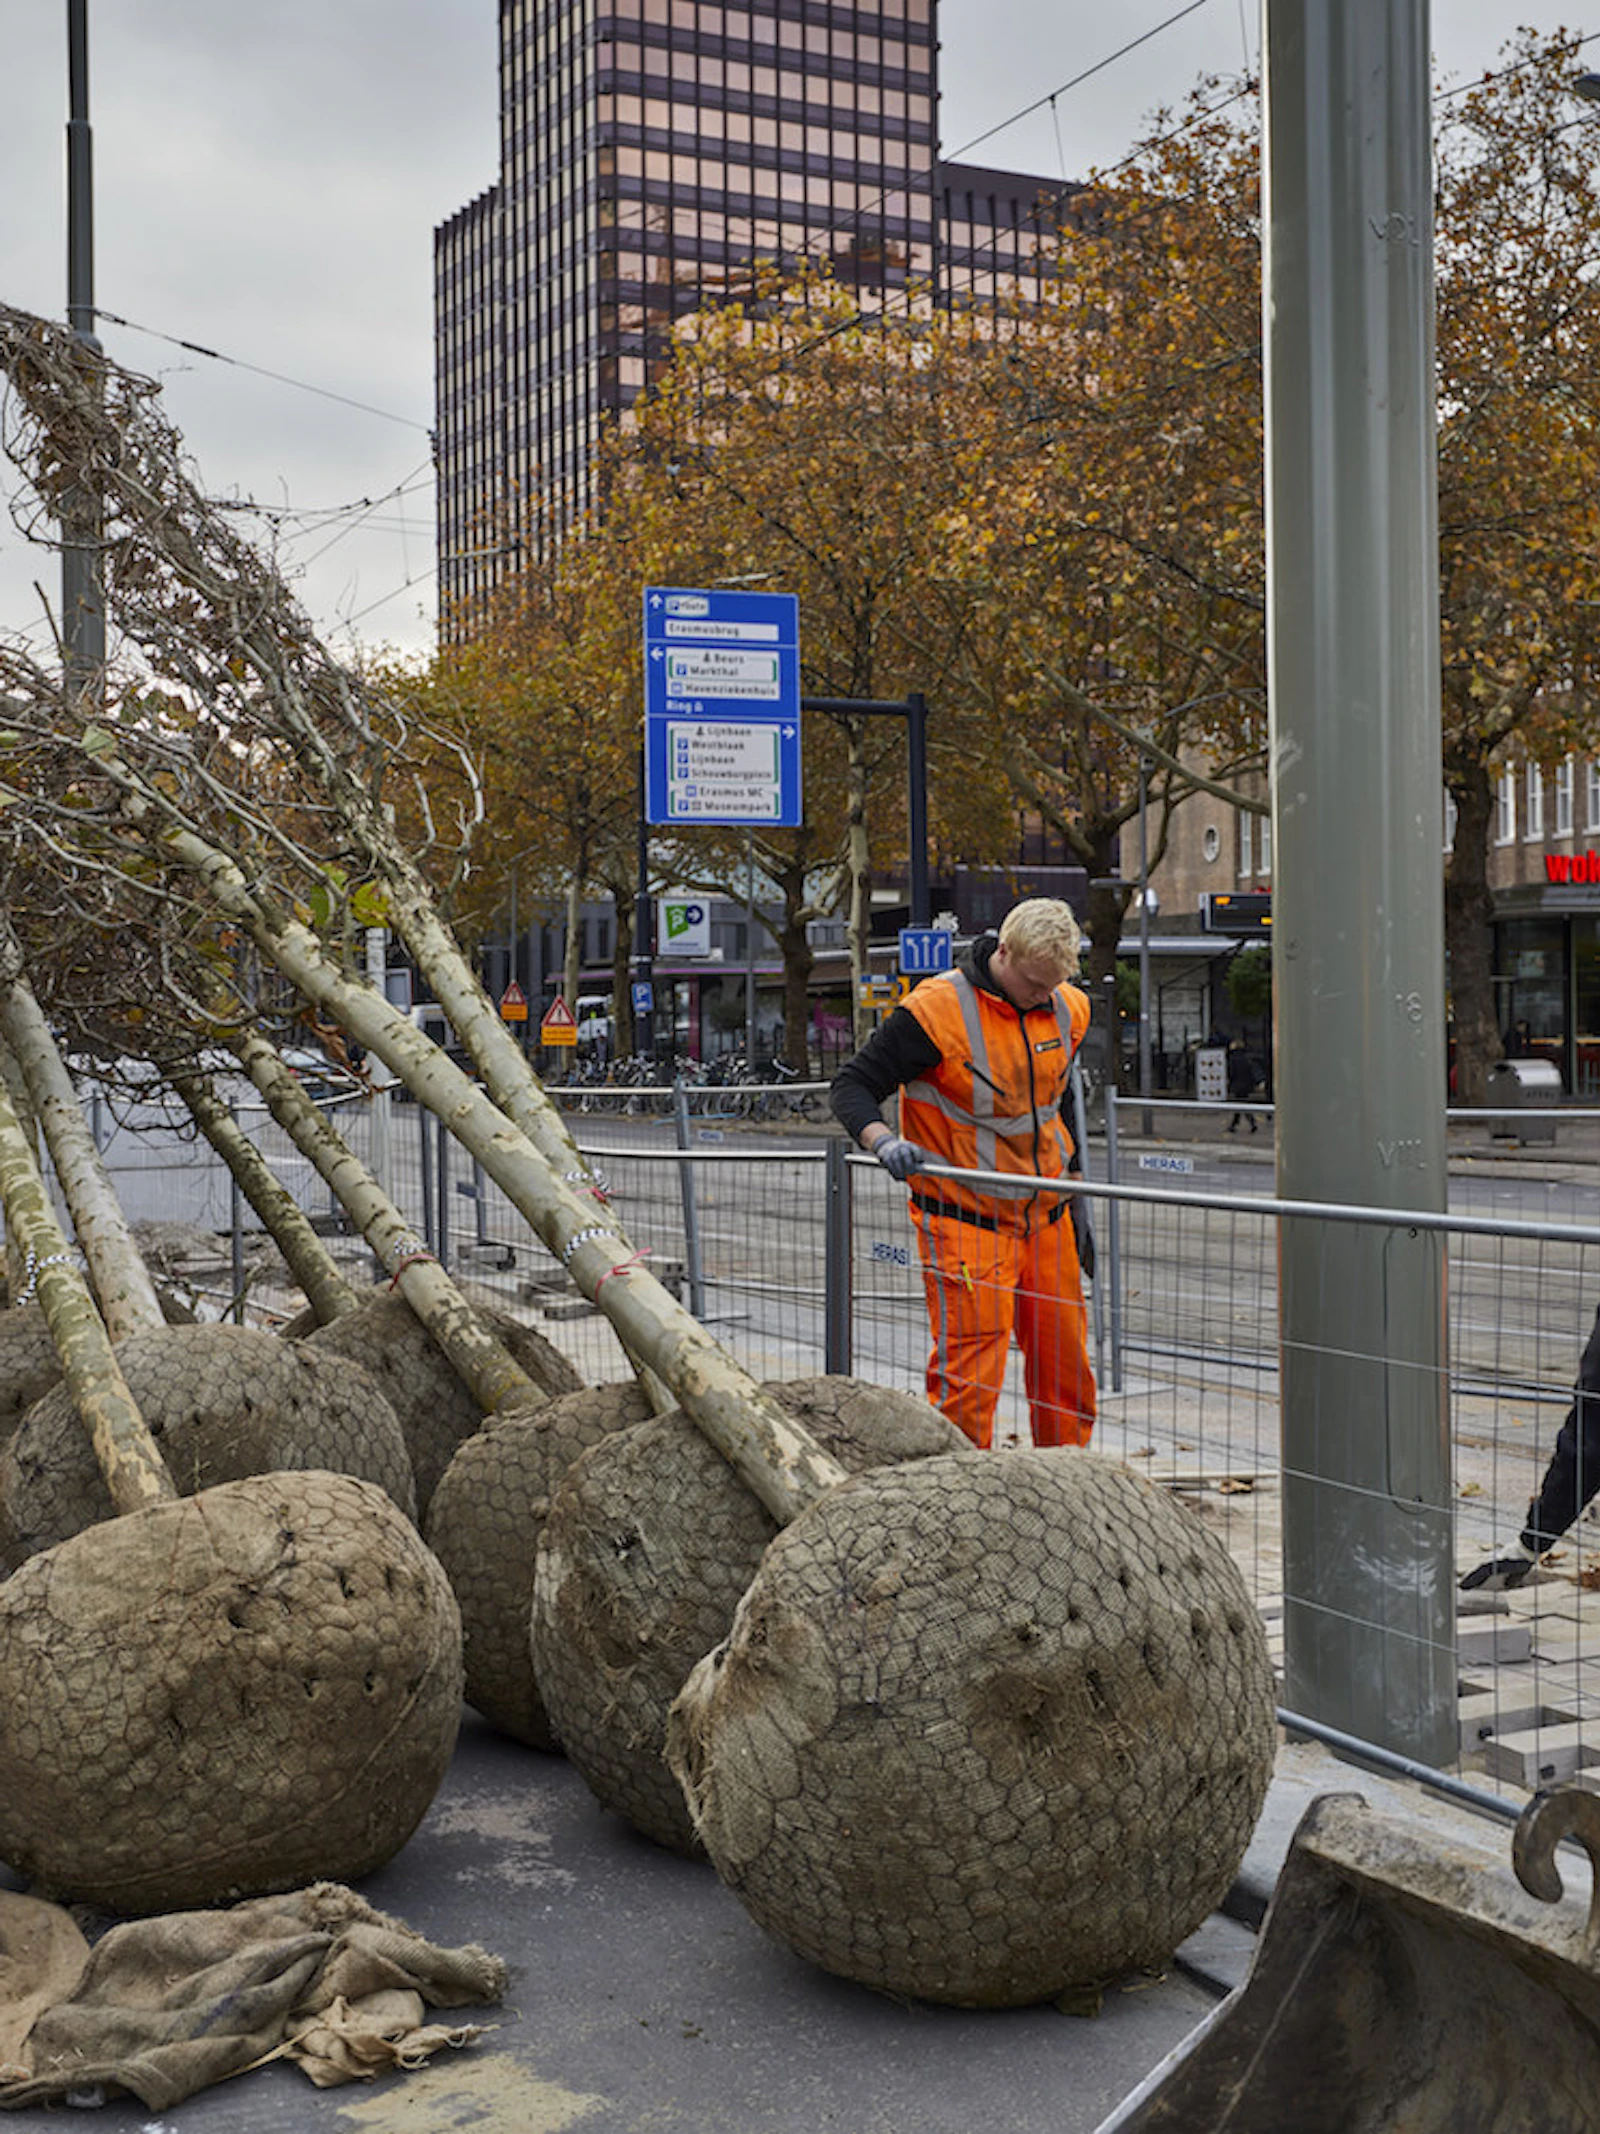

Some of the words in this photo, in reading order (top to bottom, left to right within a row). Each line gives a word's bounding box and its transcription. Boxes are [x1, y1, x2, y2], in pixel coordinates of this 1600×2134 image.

[669, 623, 740, 637] Erasmusbrug
[714, 654, 744, 664] Beurs
[690, 666, 738, 676] Markthal
[685, 685, 776, 696] Havenziekenhuis
[666, 700, 692, 714] Ring
[707, 727, 752, 738] Lijnbaan
[691, 740, 744, 750] Westblaak
[691, 753, 735, 765] Lijnbaan
[692, 769, 771, 781] Schouwburgplein
[700, 786, 744, 797] Erasmus
[748, 788, 763, 798] MC
[704, 801, 771, 812] Museumpark
[1144, 1155, 1186, 1173] HERAS
